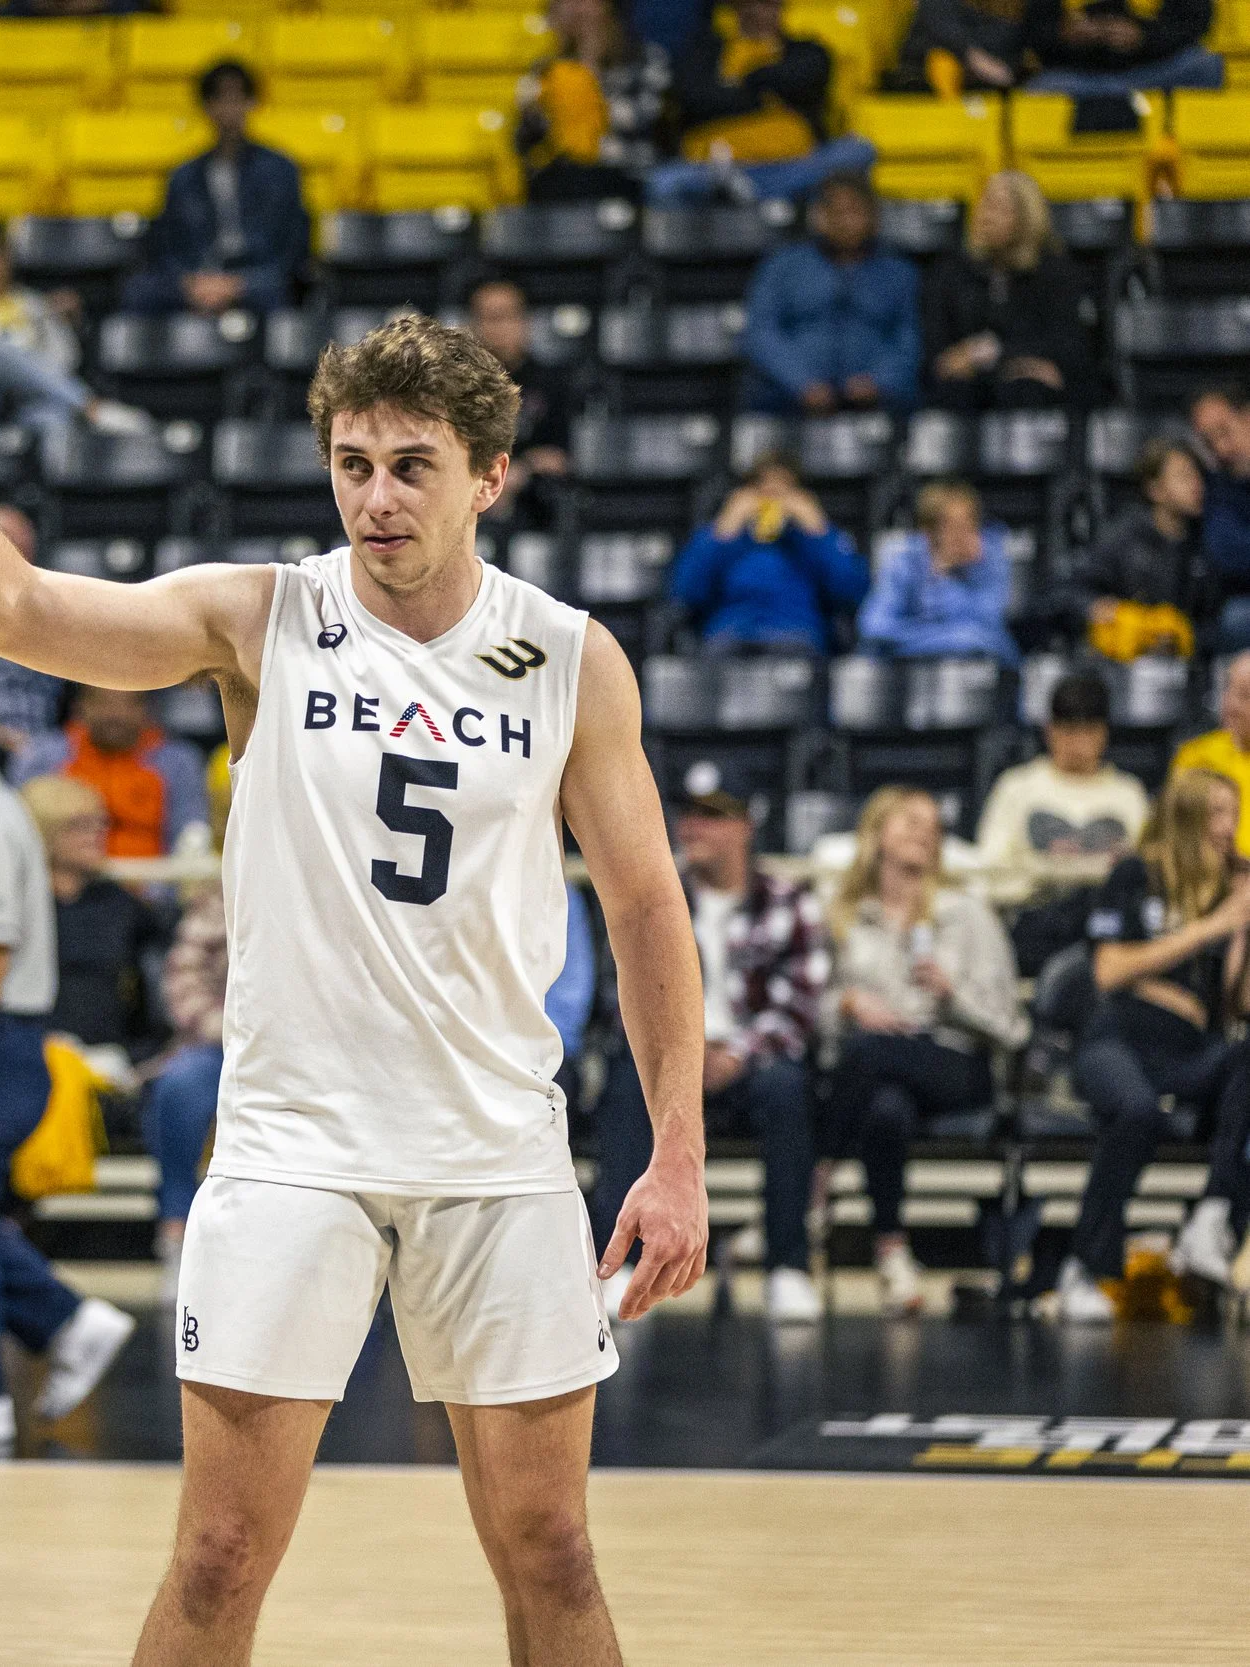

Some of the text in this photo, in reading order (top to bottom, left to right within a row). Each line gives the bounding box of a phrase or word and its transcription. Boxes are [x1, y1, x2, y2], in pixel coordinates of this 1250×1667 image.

[303, 689, 532, 760] BEACH
[370, 751, 460, 907] 5
[182, 1305, 200, 1352] LB
